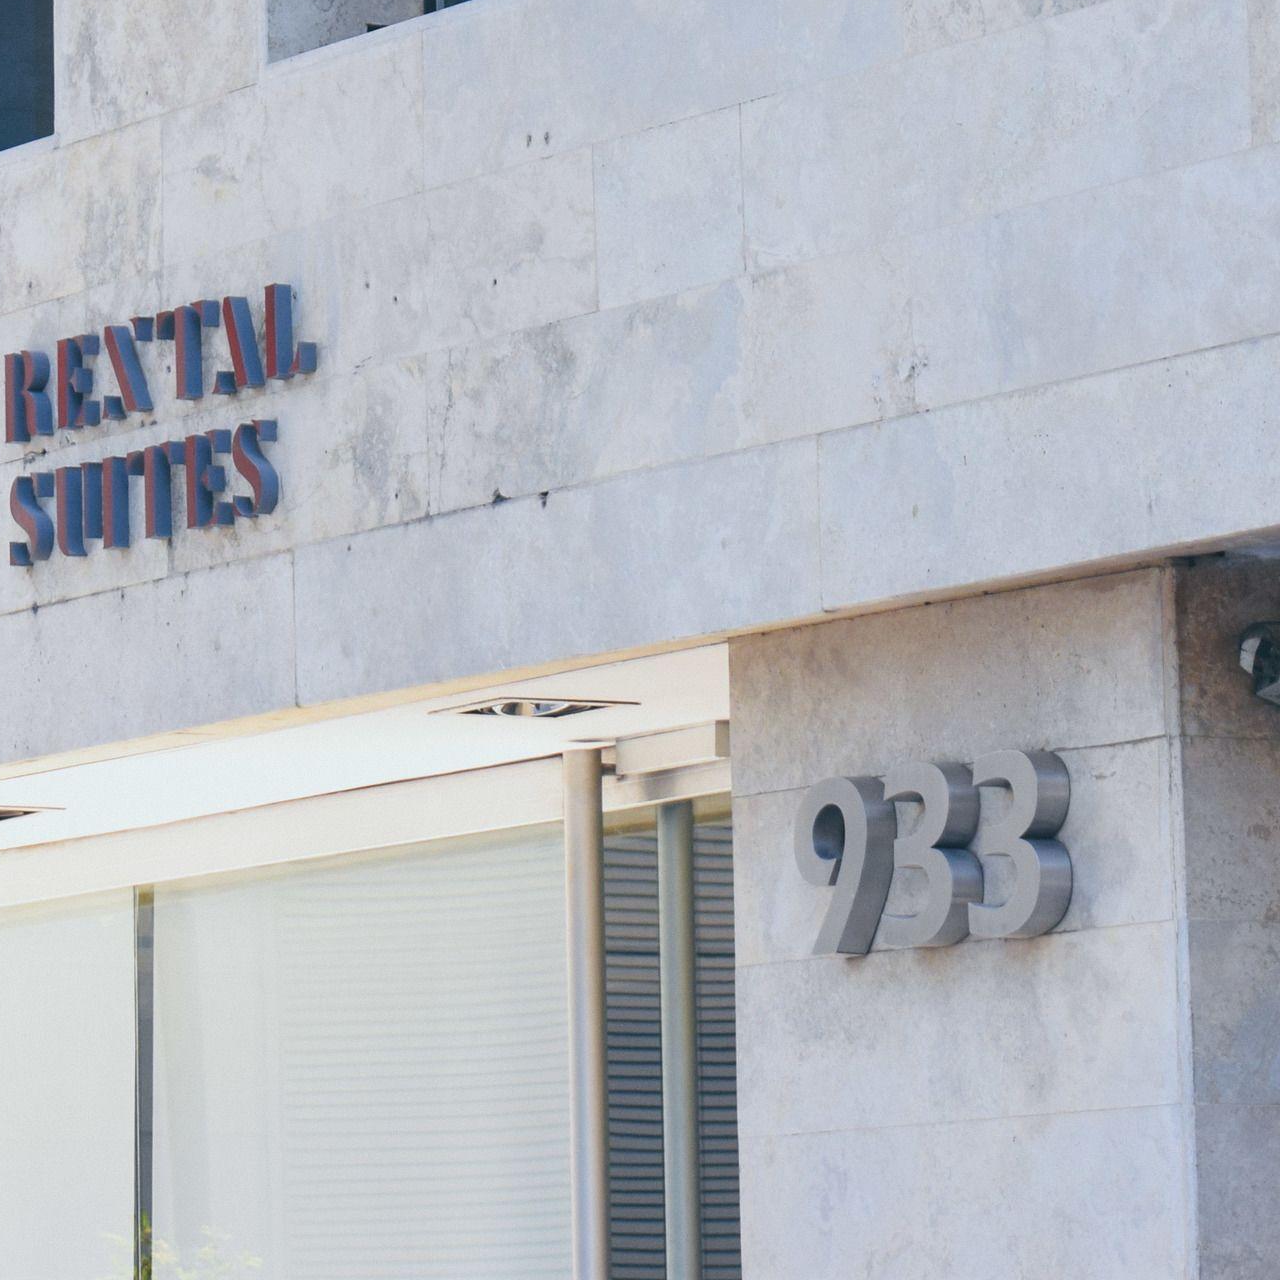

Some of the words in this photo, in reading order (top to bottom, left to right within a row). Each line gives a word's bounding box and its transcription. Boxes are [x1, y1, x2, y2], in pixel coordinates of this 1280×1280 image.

[5, 283, 317, 444] RENTAL
[9, 419, 278, 567] SUITES
[793, 750, 1073, 955] 933
